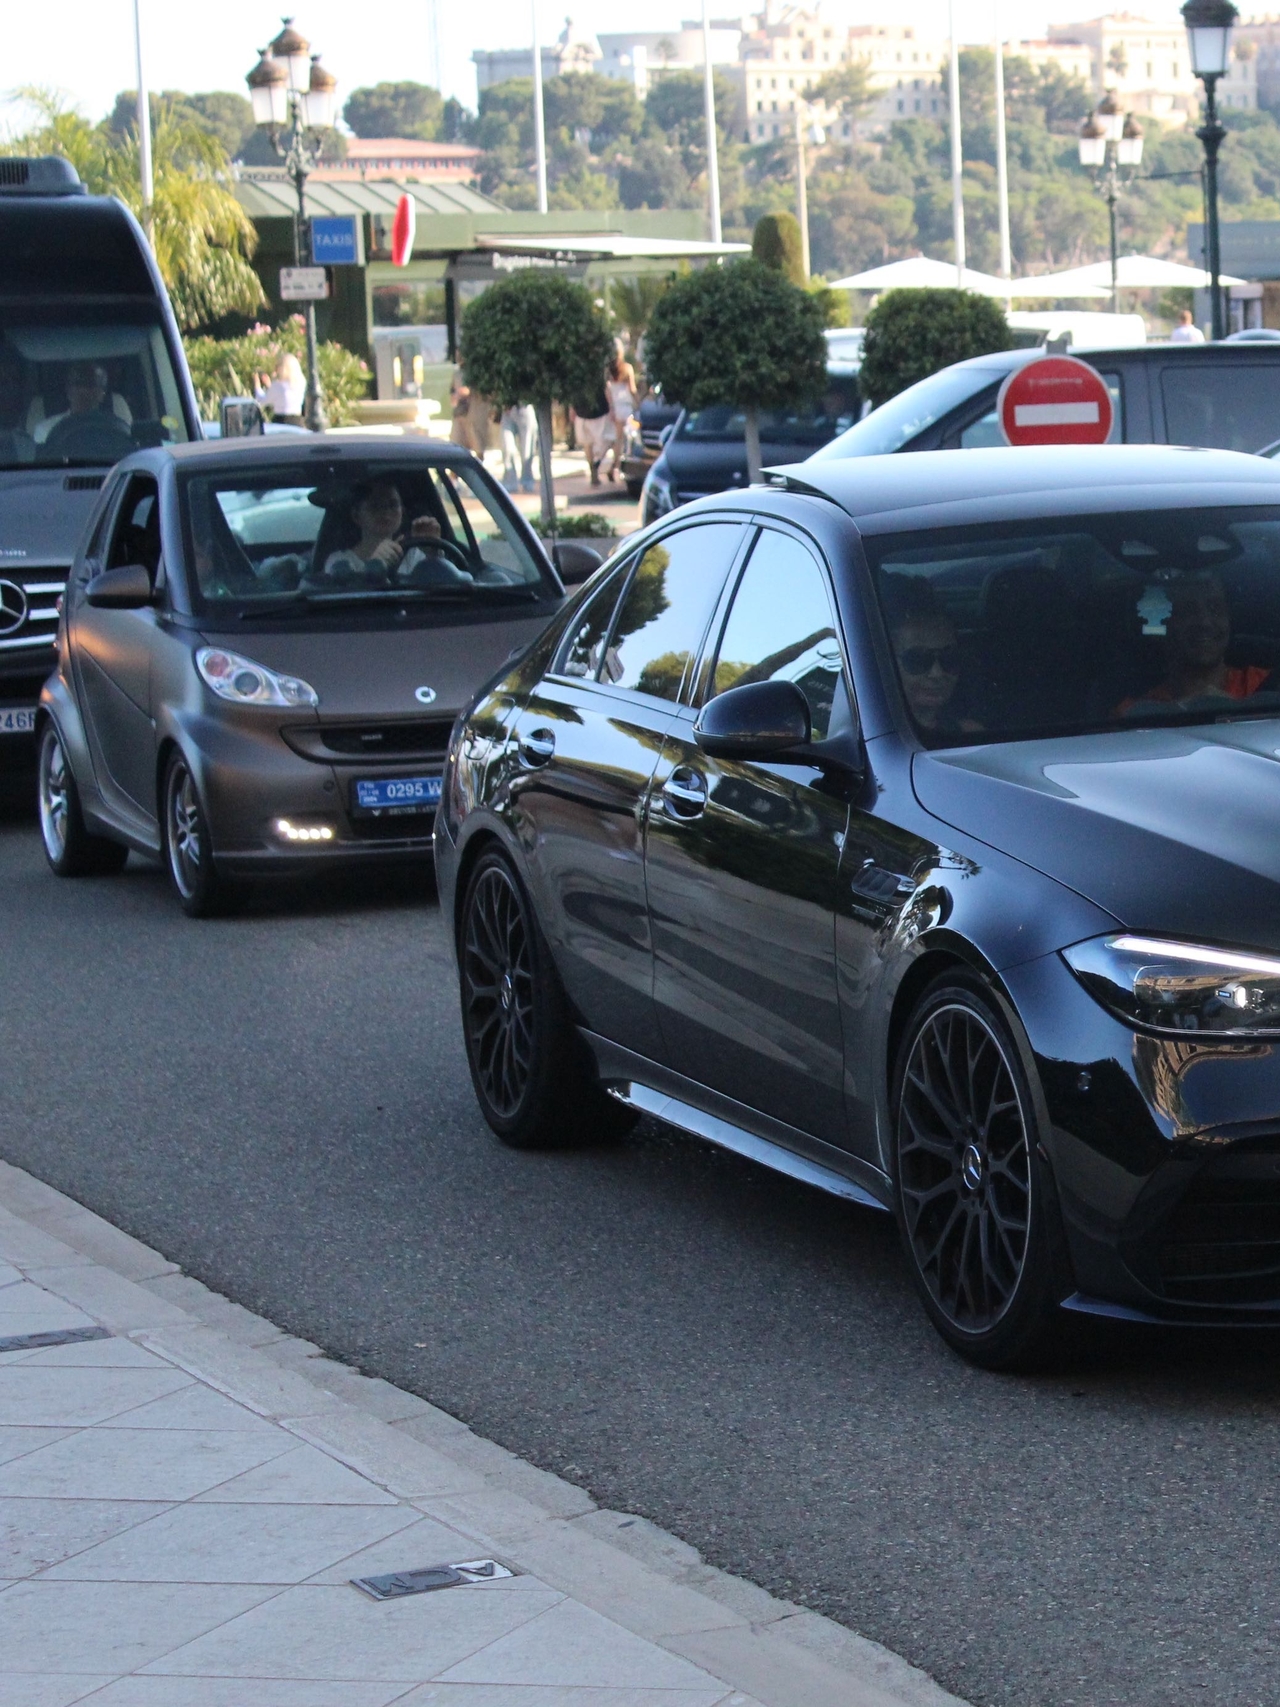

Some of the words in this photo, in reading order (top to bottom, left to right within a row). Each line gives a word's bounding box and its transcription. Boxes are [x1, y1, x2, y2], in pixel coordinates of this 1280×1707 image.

[314, 233, 353, 246] TAXIS
[0, 710, 36, 729] 46
[386, 782, 424, 799] 0295
